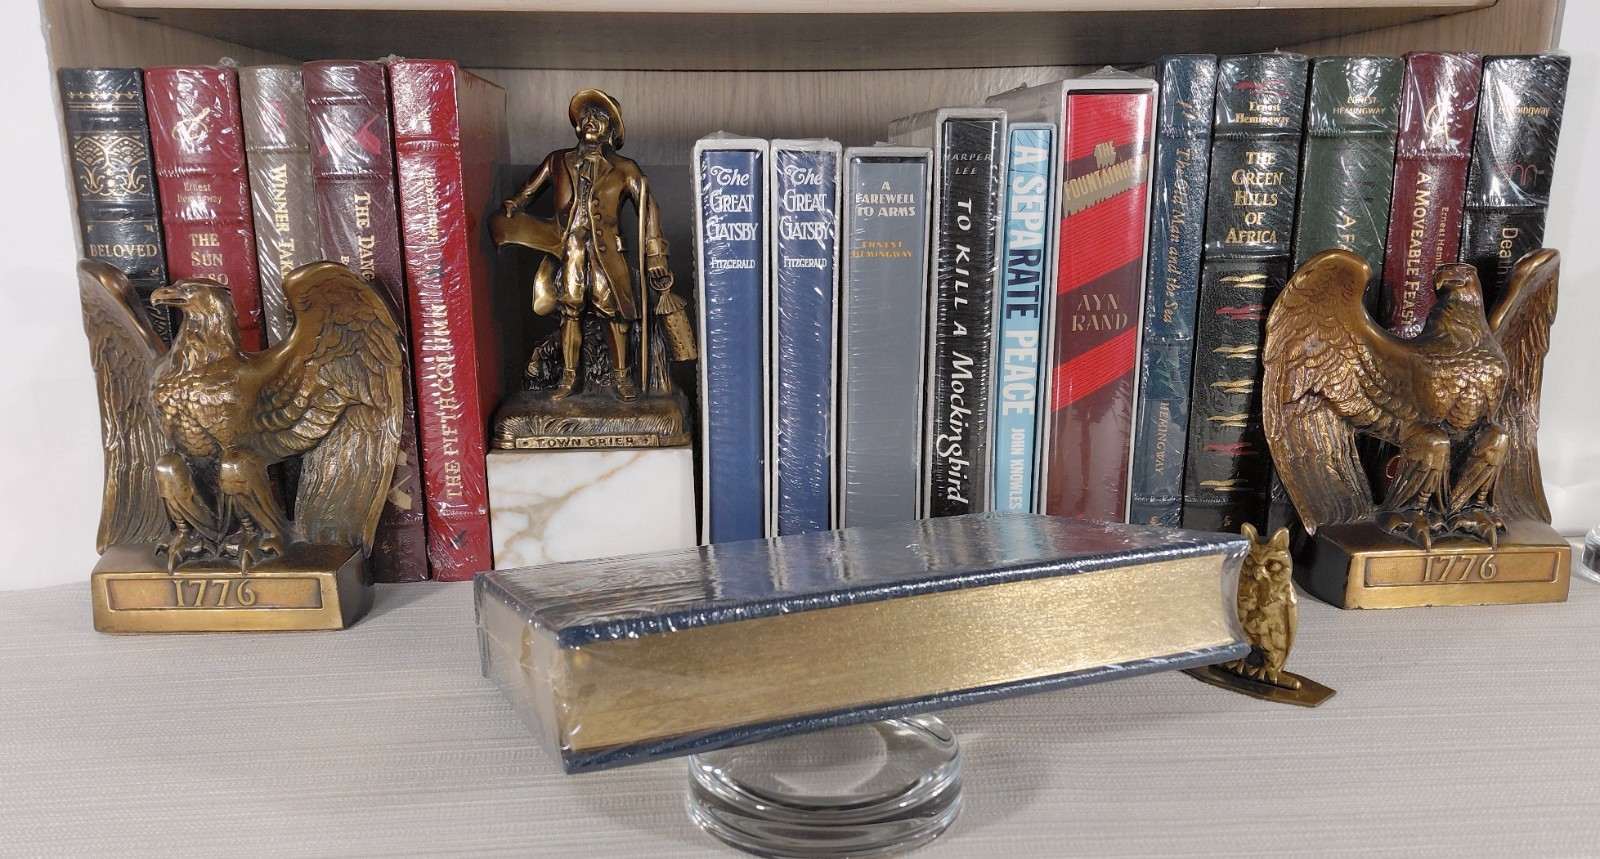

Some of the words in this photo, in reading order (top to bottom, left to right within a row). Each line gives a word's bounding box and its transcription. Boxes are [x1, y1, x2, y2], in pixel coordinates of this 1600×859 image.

[1249, 101, 1280, 112] Ernest
[1347, 96, 1377, 104] ERNEST
[1235, 113, 1290, 126] Hemingway
[1333, 107, 1386, 116] HEMINGWAY
[943, 153, 992, 161] HARPER
[1014, 145, 1049, 166] A
[1094, 141, 1116, 162] THE
[1246, 151, 1276, 165] THE
[955, 167, 977, 175] LEE
[1175, 149, 1191, 176] The
[710, 165, 749, 186] The
[784, 165, 823, 186] The
[881, 181, 891, 191] A
[1064, 153, 1149, 203] FOUNTAINHED
[1232, 169, 1284, 186] GREEN
[1415, 171, 1432, 186] A
[183, 181, 212, 192] Ernest
[1172, 177, 1190, 205] Old
[269, 163, 290, 232] WINNER
[709, 188, 755, 213] GREAT
[783, 188, 827, 212] GREAT
[855, 193, 916, 204] FAREWELL
[1233, 190, 1278, 206] HILLS
[354, 191, 371, 230] THE
[856, 206, 874, 217] TO
[877, 206, 916, 217] ARMS
[957, 199, 972, 231] TO
[1244, 212, 1266, 225] OF
[706, 215, 758, 242] GATSBY
[779, 215, 831, 241] GATSBY
[1168, 209, 1185, 243] Man
[1438, 207, 1449, 237] Ernest
[189, 233, 221, 247] THE
[1224, 228, 1278, 244] AFRICA
[1406, 191, 1431, 276] MOVEABLE
[89, 243, 158, 258] BELOVED
[852, 250, 913, 258] HEMINGWAY
[1006, 175, 1046, 319] SEPARATE
[1497, 228, 1518, 275] Death
[191, 250, 223, 267] SUN
[277, 238, 295, 279] TAK
[711, 256, 756, 269] FITZGERALD
[783, 256, 828, 270] FITZGERALD
[1166, 249, 1183, 276] and
[954, 243, 971, 311] KILL
[1164, 276, 1180, 297] the
[1078, 293, 1121, 312] AYN
[1163, 299, 1179, 324] Sea
[1400, 279, 1421, 327] FEAST
[952, 320, 968, 336] A
[1071, 313, 1128, 332] RAND
[1002, 330, 1039, 416] PEACE
[438, 396, 460, 457] FIFTH
[936, 351, 974, 504] Mockingbird
[537, 438, 581, 447] TOWN
[587, 437, 635, 447] CRIER
[1011, 428, 1025, 456] JOHN
[1154, 402, 1170, 476] HEMINGWAY
[444, 459, 463, 499] THE
[1008, 459, 1025, 510] KNOWLES
[1423, 554, 1497, 582] 1776
[173, 580, 256, 607] 1776
